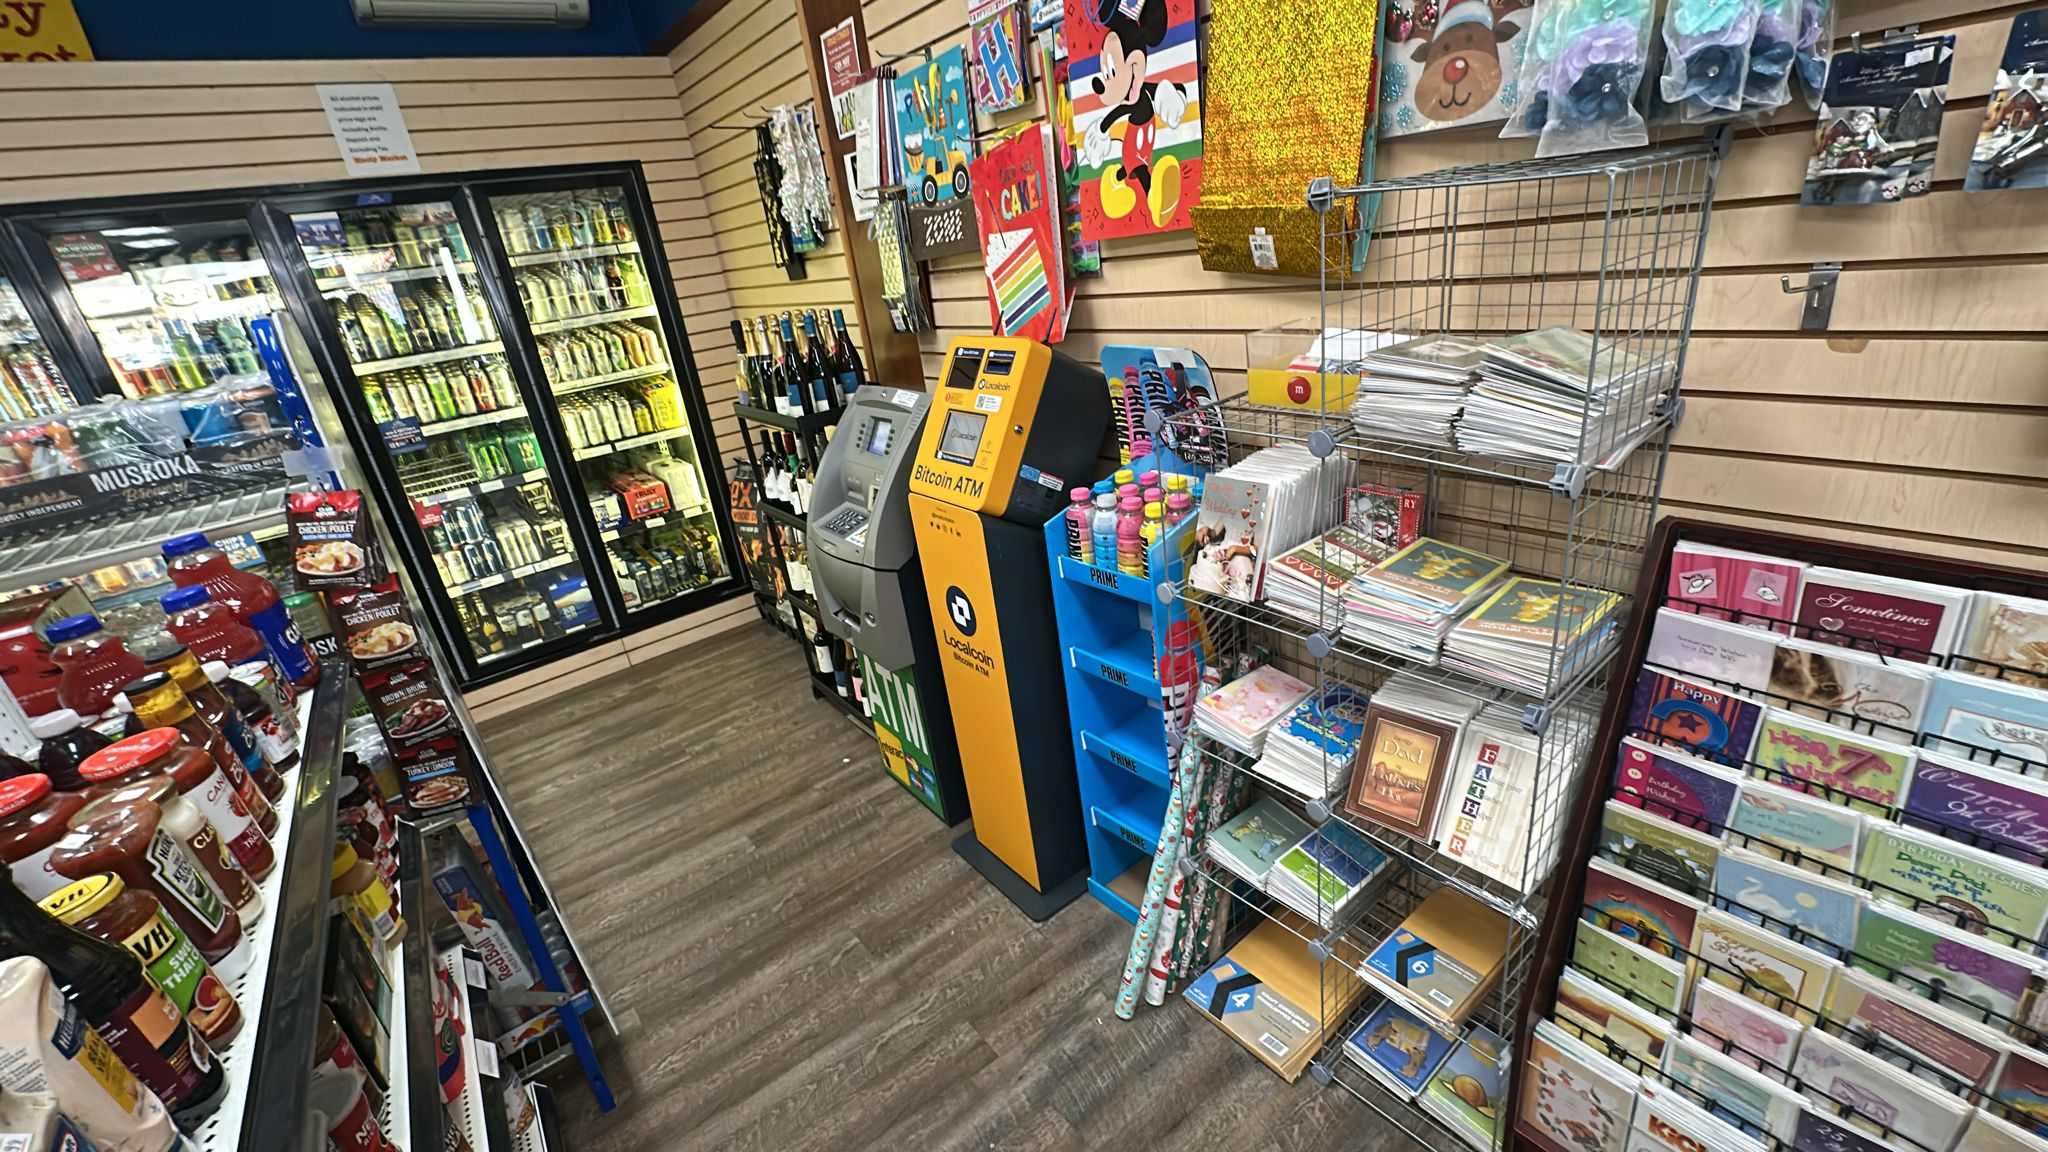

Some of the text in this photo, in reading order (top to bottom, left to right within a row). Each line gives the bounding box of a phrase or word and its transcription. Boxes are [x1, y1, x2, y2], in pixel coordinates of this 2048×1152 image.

[1001, 170, 1043, 222] CAKE!
[985, 381, 1011, 392] Localcoin
[89, 453, 202, 494] MUSKOKA
[914, 464, 985, 499] Bitcoin ATM
[26, 498, 84, 518] INDEPENDENT
[298, 524, 355, 535] CHICKEN POULET
[214, 534, 246, 550] CHIPS
[1090, 567, 1119, 590] PRIME
[345, 613, 374, 626] CHICKEN
[375, 606, 401, 619] POULET
[1815, 593, 1931, 627] Sometimes
[943, 629, 995, 670] Localcoin
[952, 651, 990, 679] Bitcoin ATM
[1101, 664, 1129, 687] PRIME
[381, 690, 405, 704] BROWN
[863, 653, 929, 756] ATM
[1674, 681, 1721, 706] Happy
[1110, 749, 1138, 774] PRIME
[1381, 737, 1425, 766] Dad
[1647, 776, 1687, 798] Birthday
[1120, 826, 1147, 850] PRIME
[1887, 837, 2043, 899] BIRTHDAY WISHES
[1896, 851, 1943, 873] Dear
[50, 888, 84, 909] VH
[1963, 883, 1984, 897] up
[132, 922, 170, 961] VH
[1697, 920, 1758, 955] Happy
[163, 961, 195, 989] THAI
[1411, 960, 1430, 974] 6
[1231, 992, 1251, 1008] 4
[1814, 1124, 1848, 1143] 25
